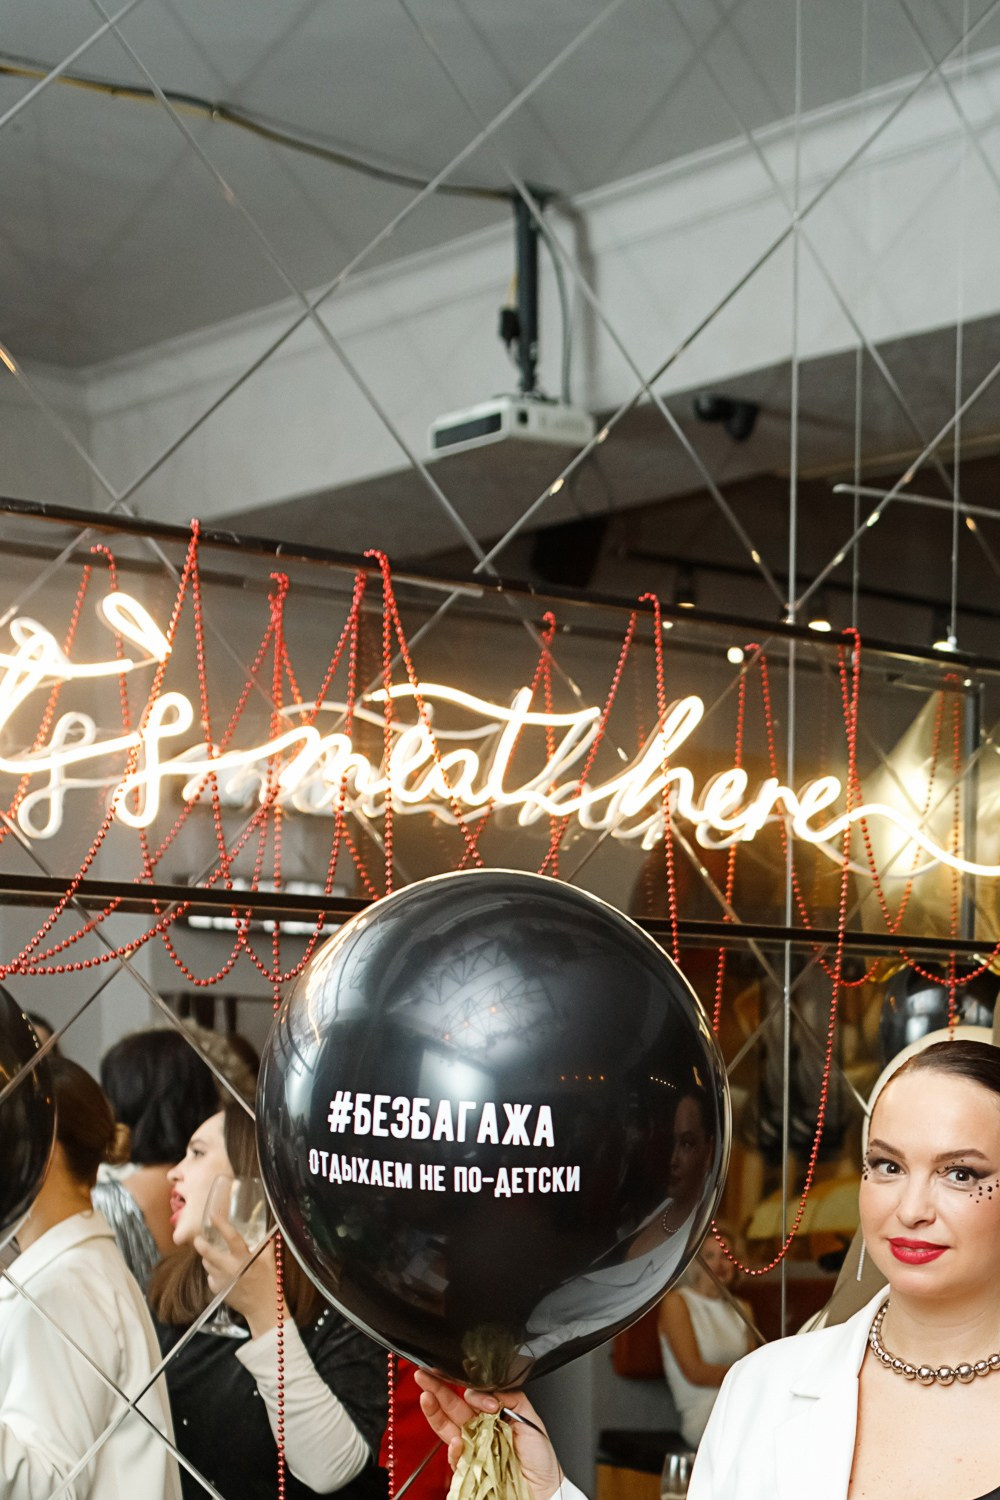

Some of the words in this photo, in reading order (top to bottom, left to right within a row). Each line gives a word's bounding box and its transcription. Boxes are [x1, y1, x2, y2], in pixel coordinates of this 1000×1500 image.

[327, 1091, 555, 1147] #БЕЗБАГАЖА
[309, 1149, 413, 1189] ОТДЫХАЕМ
[419, 1164, 446, 1192] НЕ
[453, 1166, 581, 1198] ПО-ДЕТСКИ
